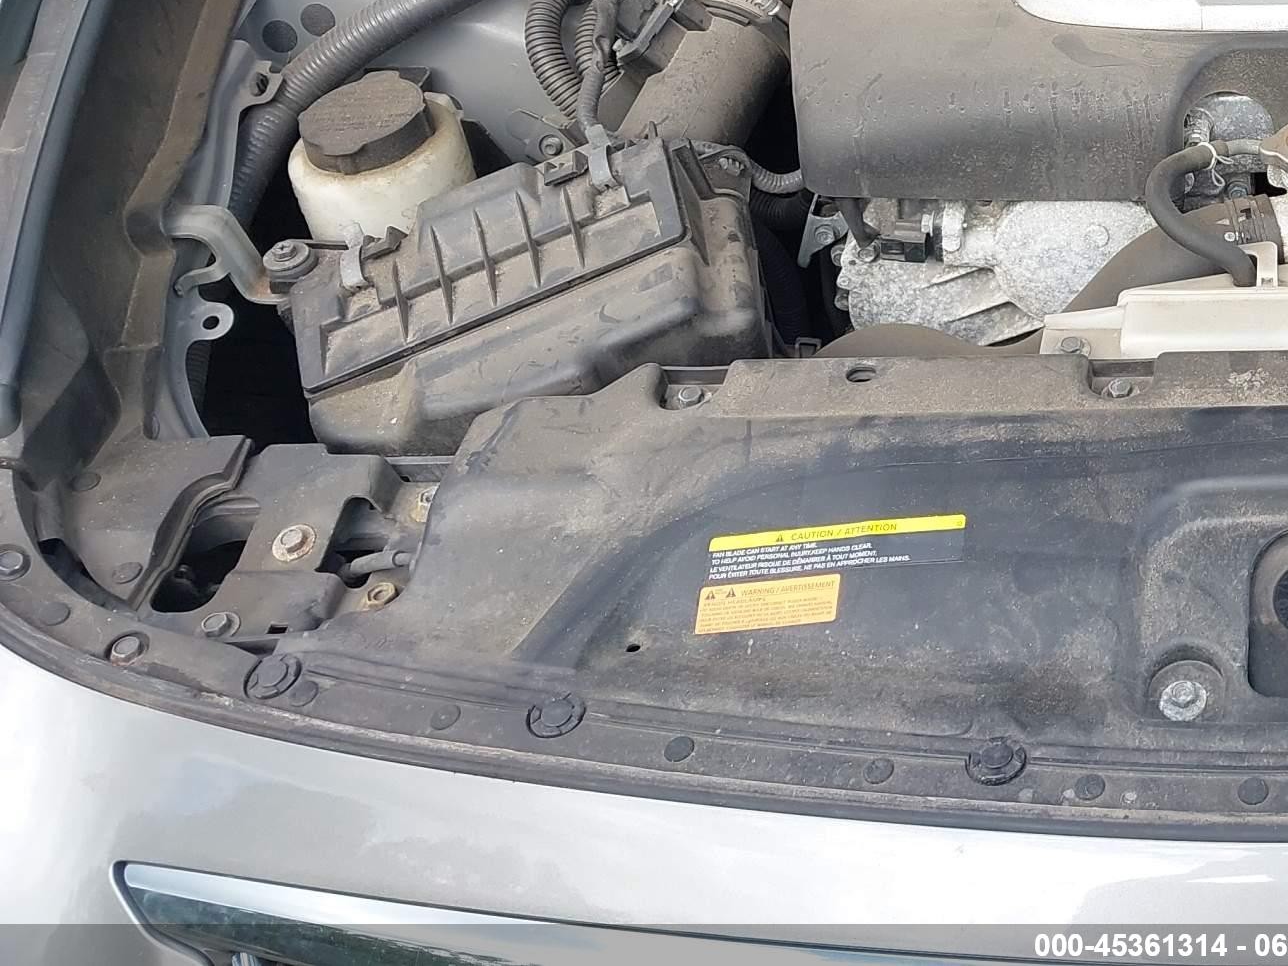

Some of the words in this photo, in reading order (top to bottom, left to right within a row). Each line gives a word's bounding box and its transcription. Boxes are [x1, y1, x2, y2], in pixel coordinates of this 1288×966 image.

[791, 529, 834, 541] CAUTION
[845, 523, 897, 535] ATTENTION
[712, 551, 725, 559] FAN
[725, 549, 746, 557] BLADE
[746, 548, 760, 556] CAN
[760, 546, 779, 554] START
[737, 555, 757, 563] AVOID
[757, 552, 791, 561] PERSONAL
[828, 545, 851, 553] HANDS
[718, 562, 757, 572] VENTILATEUR
[757, 561, 782, 569] RISQUE
[832, 553, 848, 561] TOUT
[728, 570, 749, 579] ÉVITER
[749, 568, 769, 576] TOUTE
[837, 557, 876, 567] APPROCHER
[743, 587, 775, 596] WARNING
[780, 580, 836, 592] AVERTISSEMENT
